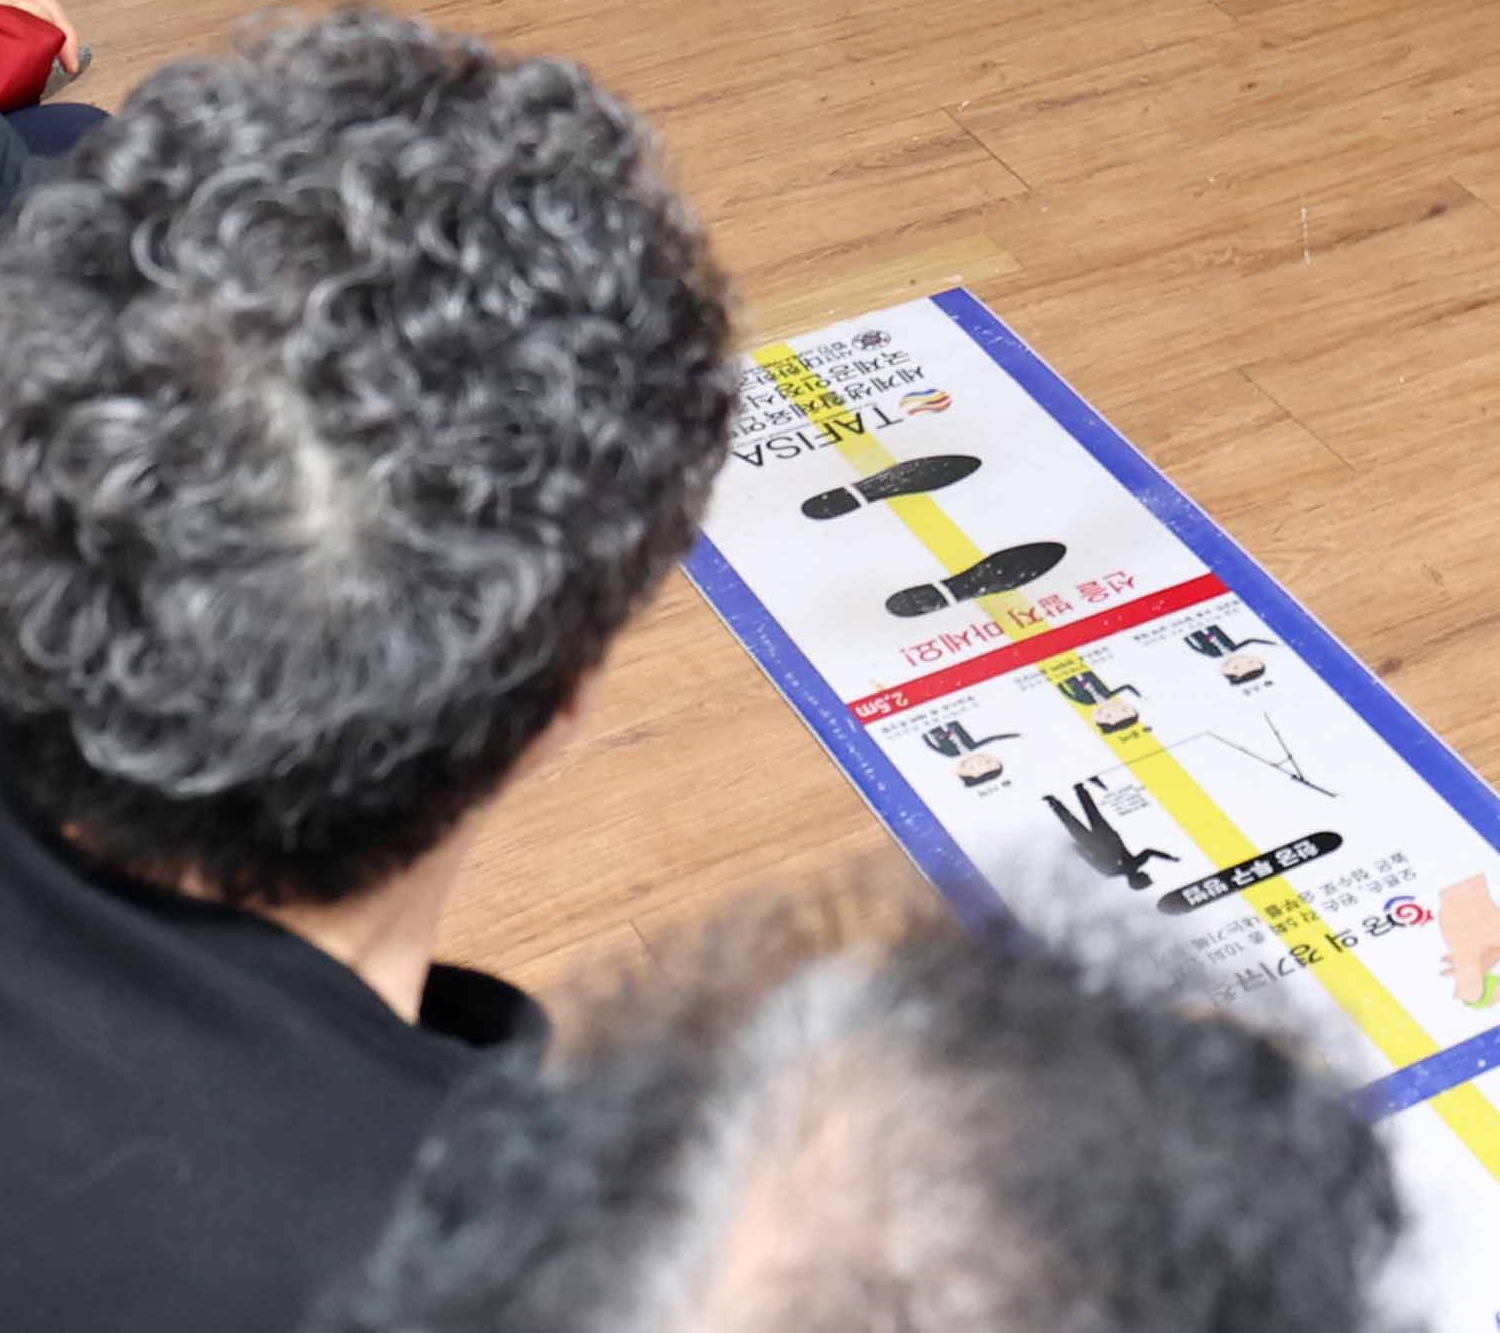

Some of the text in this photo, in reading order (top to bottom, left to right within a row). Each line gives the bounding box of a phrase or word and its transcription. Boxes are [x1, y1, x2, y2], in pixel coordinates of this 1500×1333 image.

[732, 365, 925, 439] 세계생활체육연
[731, 405, 904, 468] TAFISA
[1075, 570, 1136, 604] 선을
[1006, 593, 1075, 629] 밟지
[900, 621, 1006, 668] 마세요!
